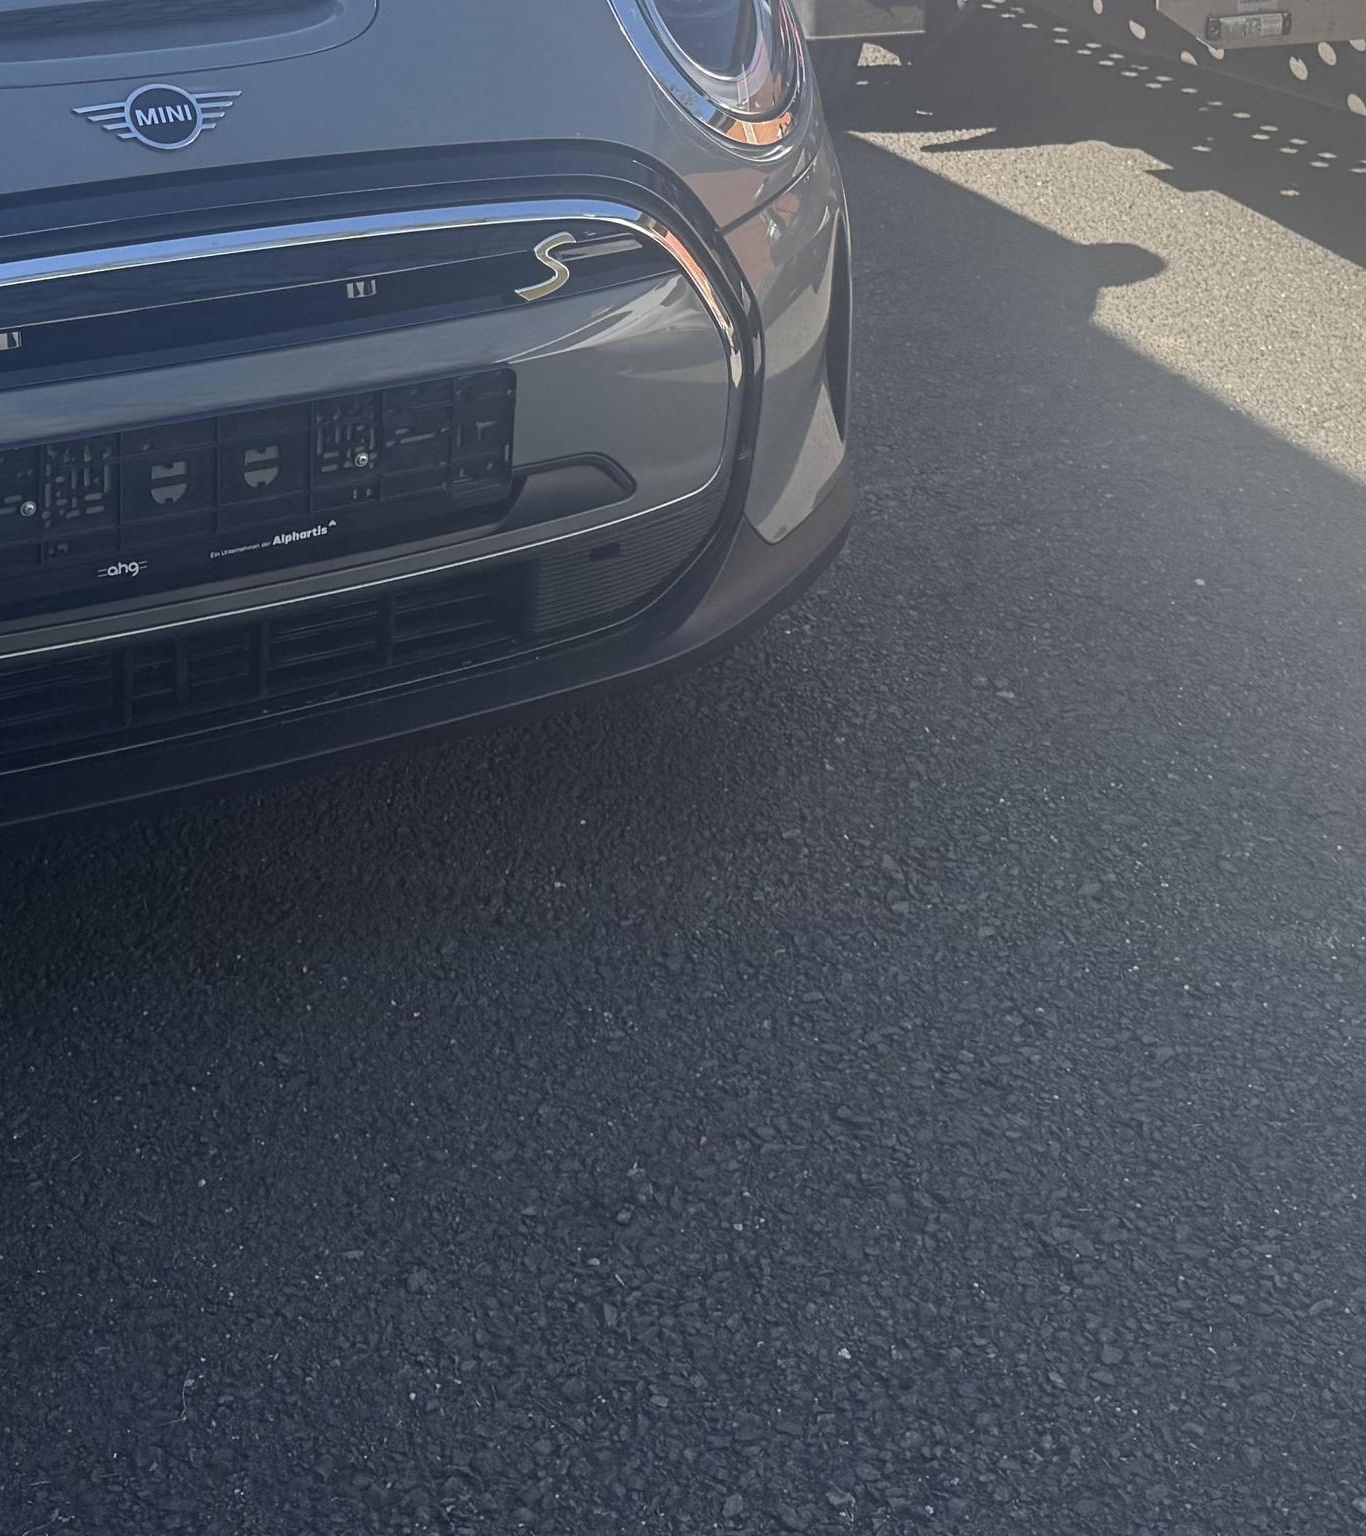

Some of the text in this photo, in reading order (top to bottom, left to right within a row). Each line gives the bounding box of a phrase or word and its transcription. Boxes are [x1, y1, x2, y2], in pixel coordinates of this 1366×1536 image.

[134, 104, 193, 127] MINI
[514, 231, 577, 301] S
[272, 524, 329, 546] Alphartis
[106, 560, 141, 578] ahg
